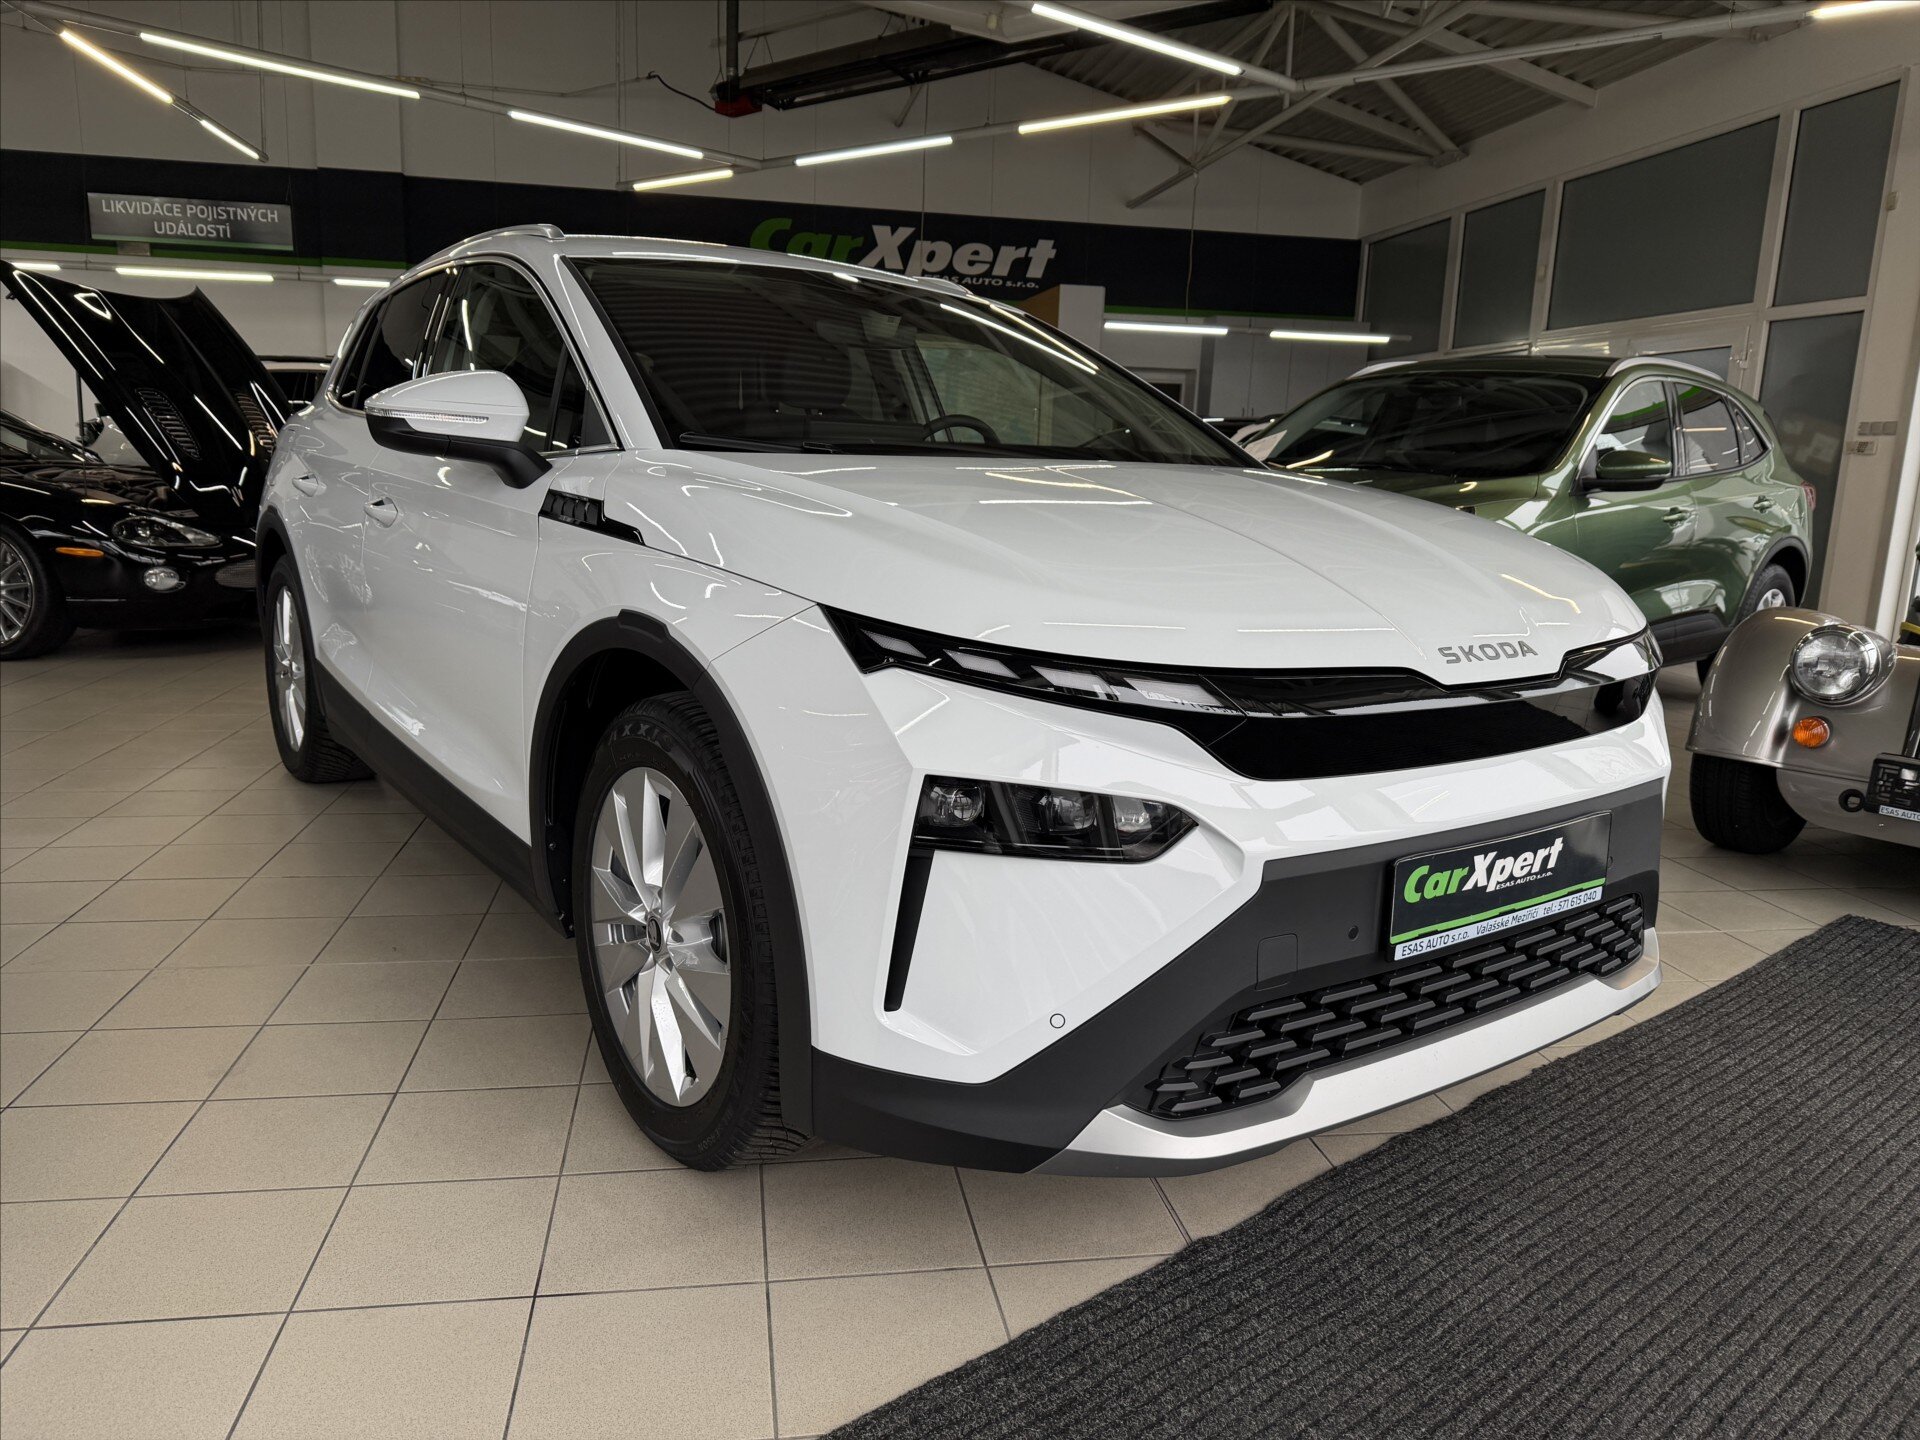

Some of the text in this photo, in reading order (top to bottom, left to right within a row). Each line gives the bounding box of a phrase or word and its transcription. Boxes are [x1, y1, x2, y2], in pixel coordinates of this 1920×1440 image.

[102, 199, 279, 223] LIKVIDACE POJISTNÝCH
[153, 219, 231, 239] UDÁLOSTÍ
[750, 217, 1057, 278] CarXpert
[961, 276, 1004, 287] AUTO
[1005, 280, 1039, 289] s.r.o.
[1880, 806, 1900, 816] ESAS
[1403, 836, 1564, 904] CarXpert
[1496, 880, 1515, 890] ESAS
[1516, 874, 1536, 885] AUTO
[1401, 940, 1424, 957] ESAS
[1425, 934, 1450, 952] AUTO
[1451, 931, 1469, 943] s.r.o.
[1476, 917, 1510, 935] Valašské
[1543, 902, 1557, 915] tel.:
[1557, 898, 1570, 911] 571
[1570, 894, 1583, 907] 615
[1583, 890, 1597, 903] 040
